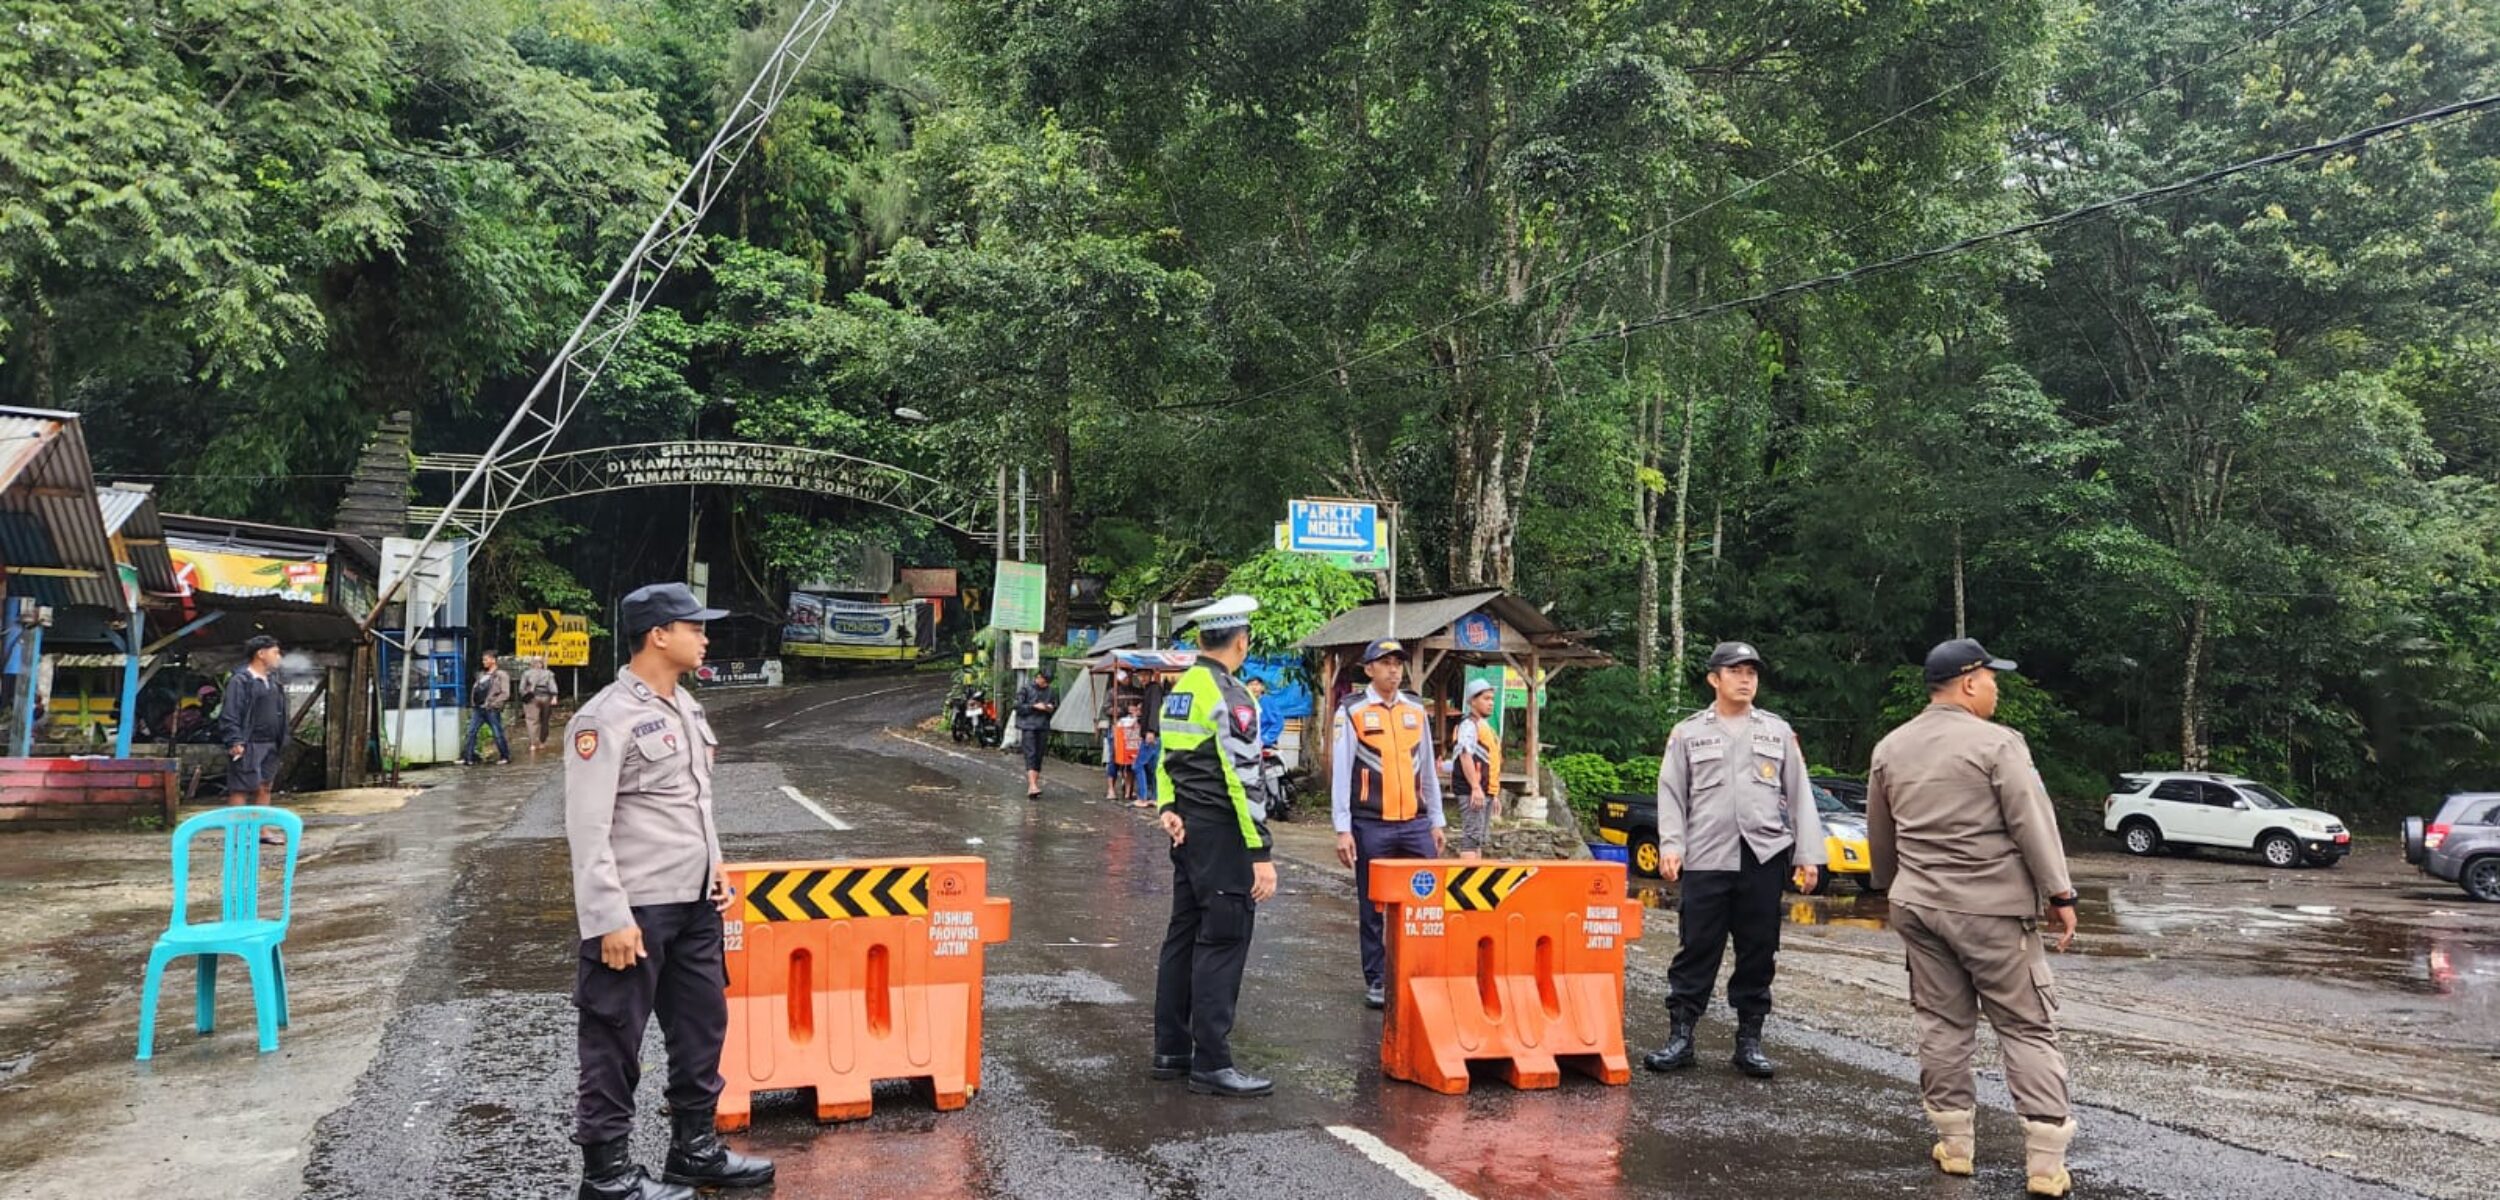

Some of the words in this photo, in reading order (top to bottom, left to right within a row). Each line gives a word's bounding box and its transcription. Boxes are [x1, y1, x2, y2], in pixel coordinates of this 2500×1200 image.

[660, 443, 738, 457] SELAMAT
[607, 460, 627, 473] DI
[623, 470, 687, 485] TAMAN
[690, 469, 747, 483] HUTAN
[752, 474, 795, 487] RAYA
[1297, 502, 1362, 522] PARKIR
[1308, 521, 1361, 537] MOBIL
[933, 911, 973, 926] DISHUB
[1405, 906, 1413, 921] P
[1415, 907, 1443, 921] APBD
[1587, 906, 1618, 919] DISHUB
[929, 926, 979, 941] PROVINSI
[1422, 922, 1444, 936] 2022
[1583, 920, 1622, 936] PROVINSI
[933, 941, 969, 955] JATIM
[1586, 935, 1613, 949] JATIM
